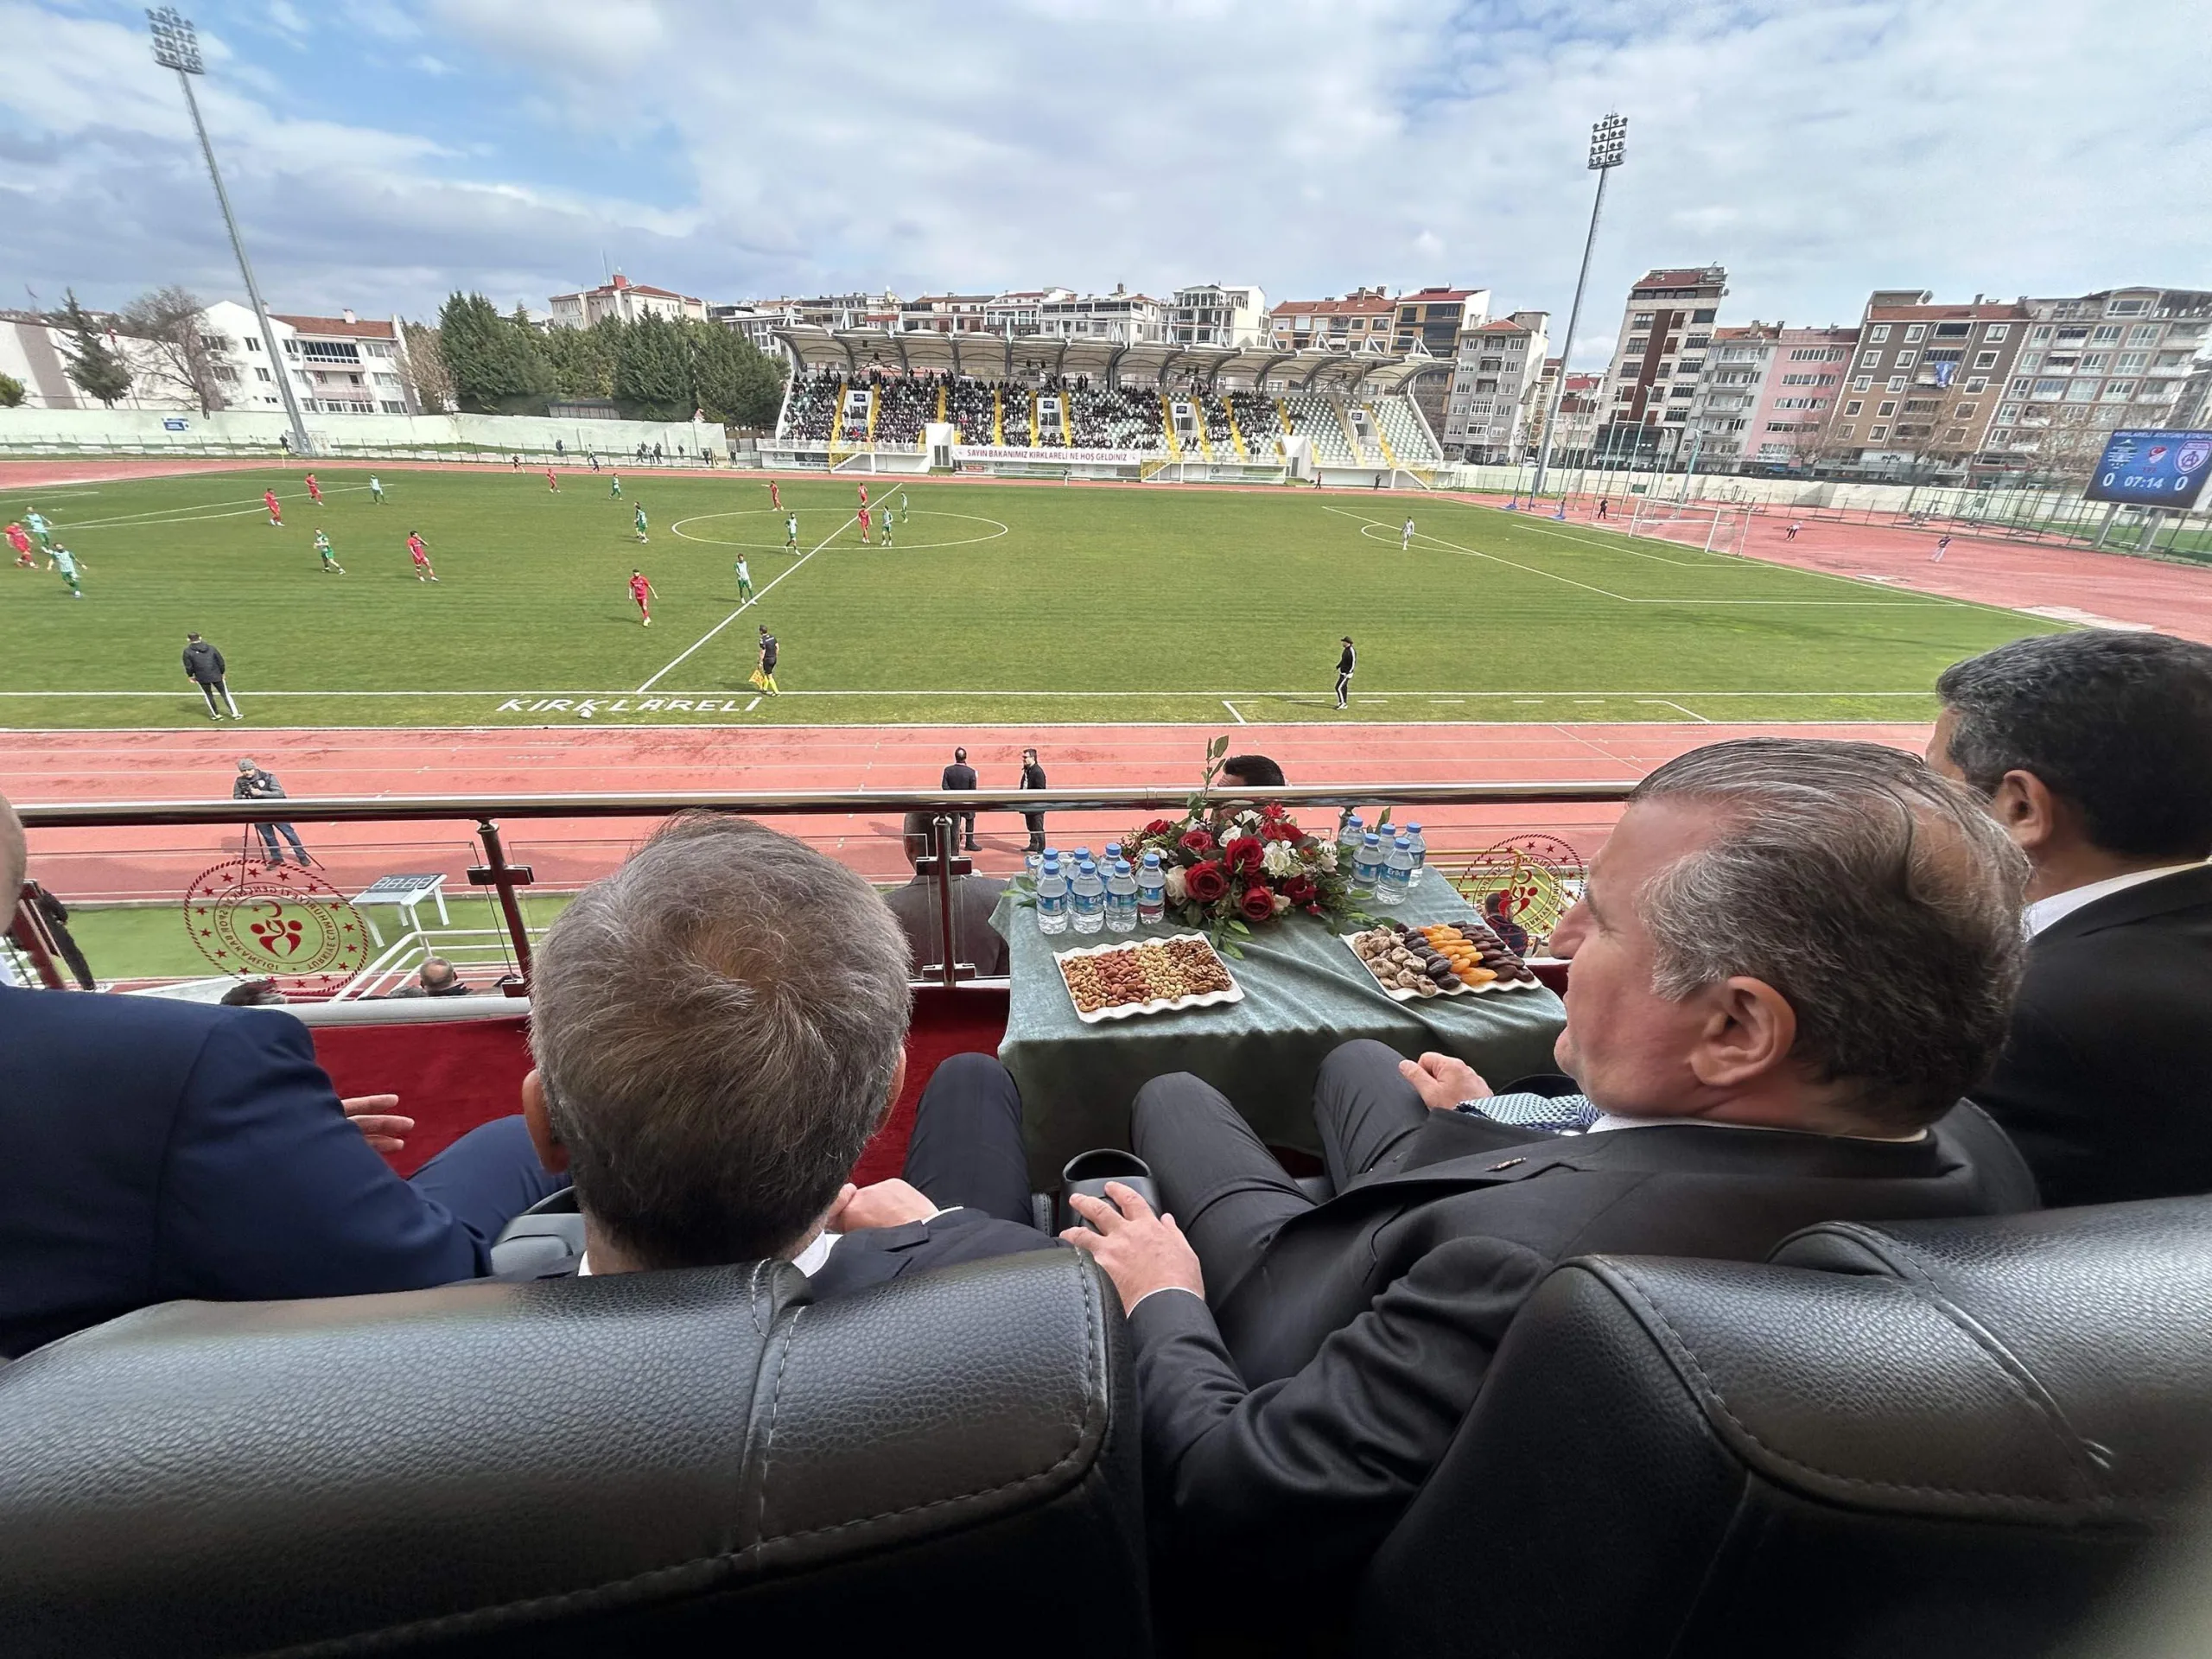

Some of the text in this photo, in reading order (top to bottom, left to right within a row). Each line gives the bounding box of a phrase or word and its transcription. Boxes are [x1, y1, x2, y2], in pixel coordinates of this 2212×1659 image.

[988, 449, 1027, 458] BAKANIMIZ
[1029, 451, 1068, 460] KIRKLARELİ
[1080, 452, 1095, 462] HOŞ
[2102, 473, 2188, 491] 0 07:14 0
[495, 696, 763, 712] KIRKLARELİ
